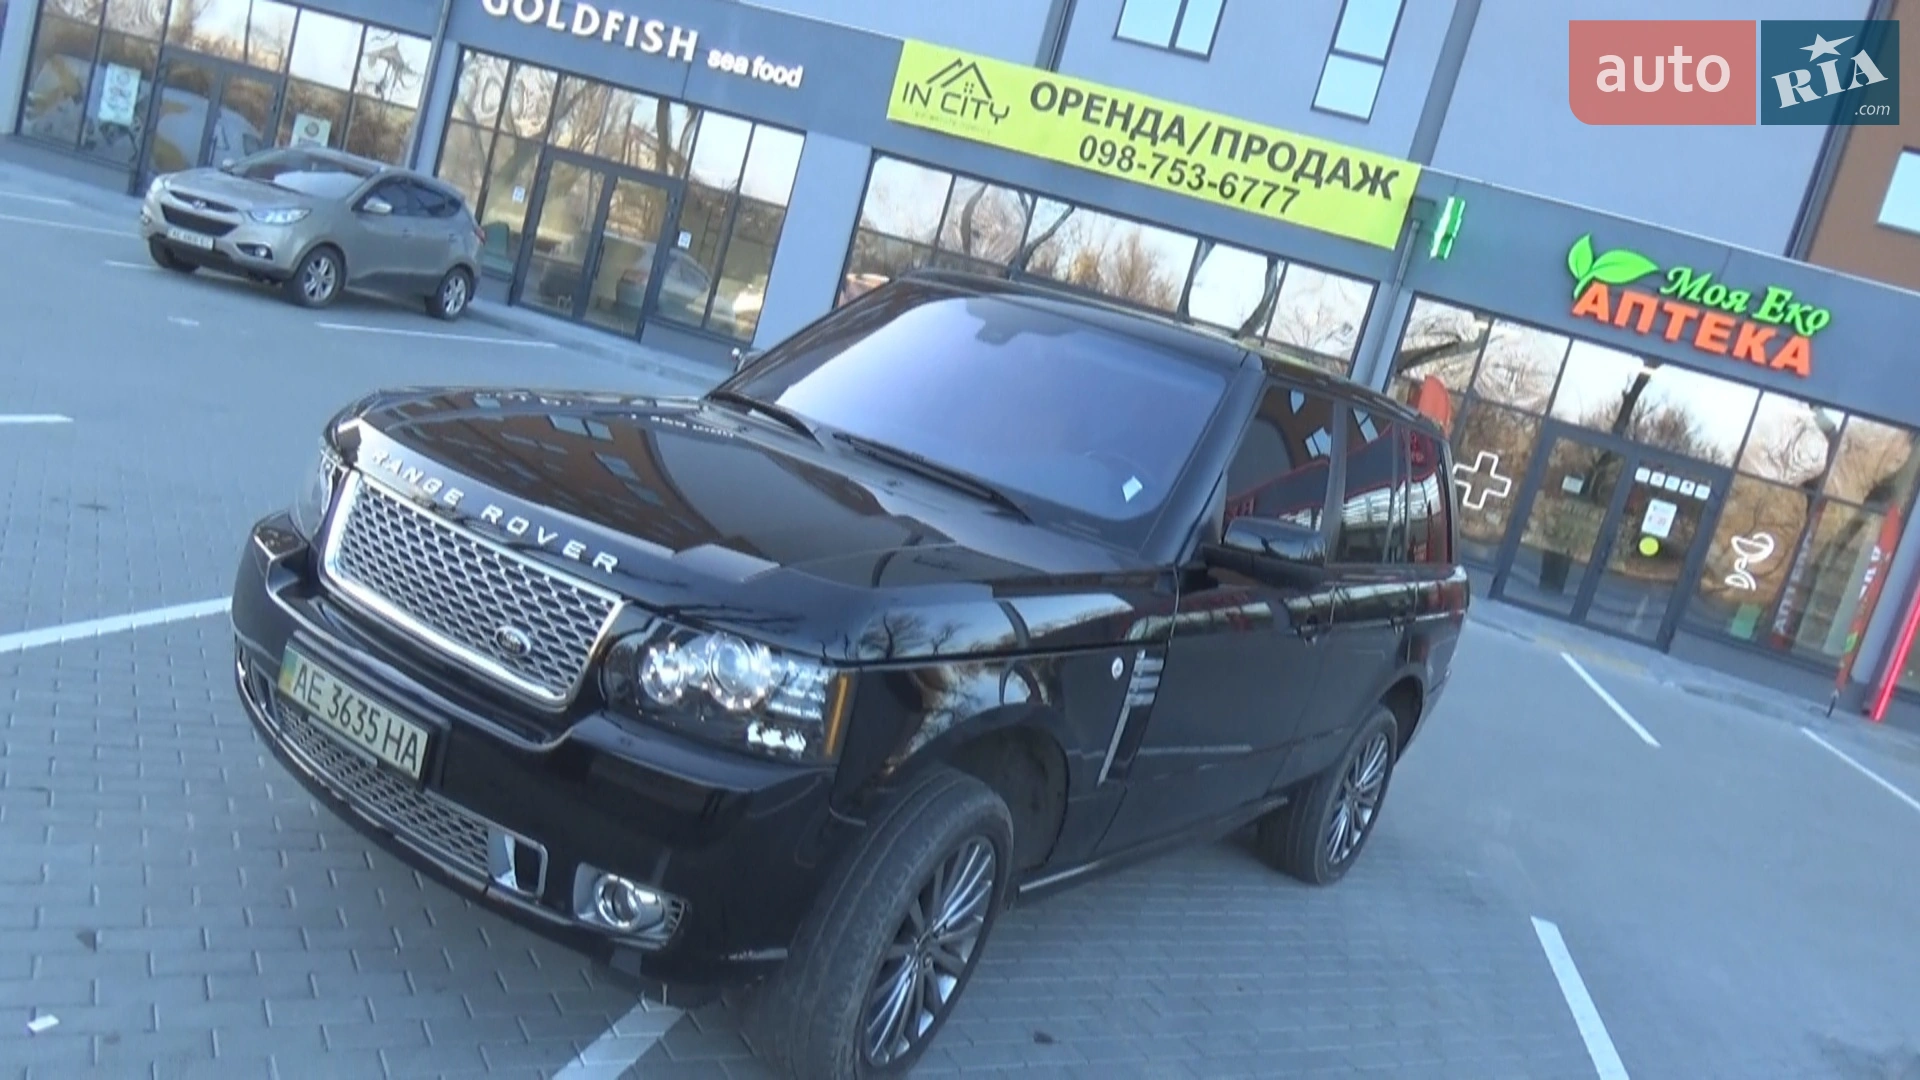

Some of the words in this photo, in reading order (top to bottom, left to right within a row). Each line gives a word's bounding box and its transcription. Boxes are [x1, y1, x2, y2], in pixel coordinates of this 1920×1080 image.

[707, 49, 749, 76] sea
[752, 55, 804, 89] food
[902, 81, 933, 108] IN
[1029, 80, 1400, 201] ОРЕНДА/ПРОДАЖ
[1078, 135, 1301, 214] 098-753-6777
[1571, 281, 1812, 376] АПТЕКА
[1659, 266, 1751, 314] Моя
[1751, 285, 1831, 337] Еко
[372, 450, 465, 506] RANGE
[480, 503, 619, 575] ROVER
[292, 663, 326, 712] AE
[326, 683, 381, 744] 3635
[381, 717, 419, 774] HA
